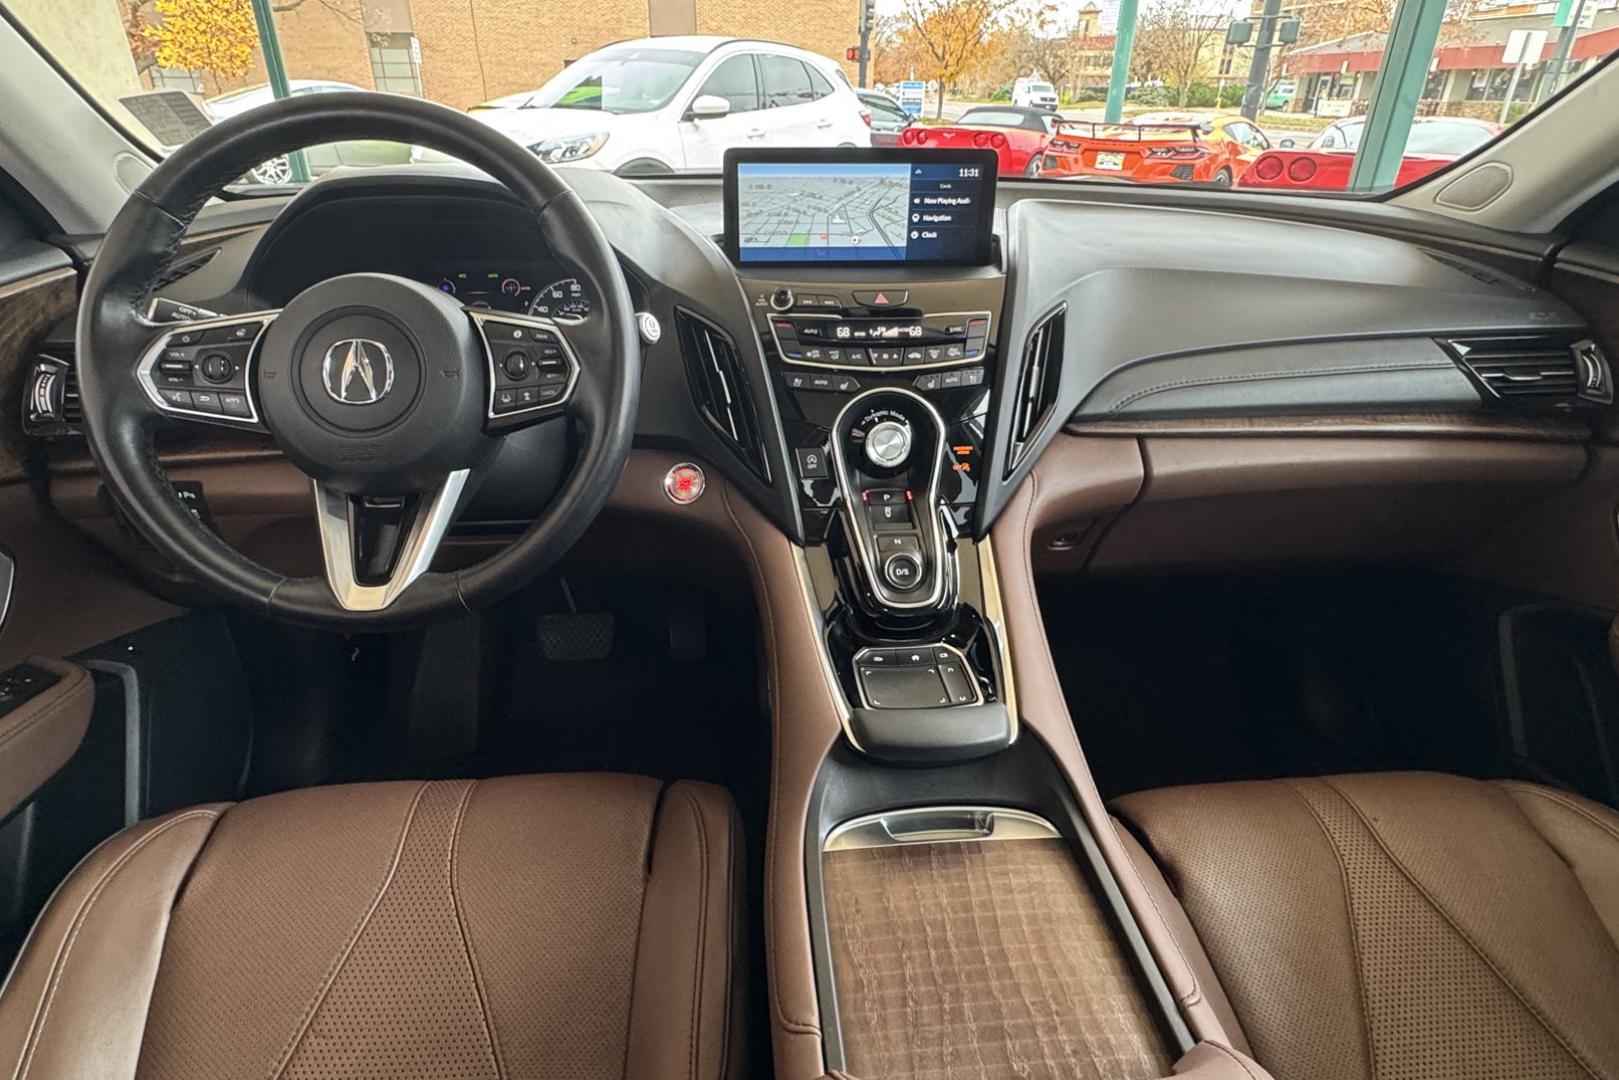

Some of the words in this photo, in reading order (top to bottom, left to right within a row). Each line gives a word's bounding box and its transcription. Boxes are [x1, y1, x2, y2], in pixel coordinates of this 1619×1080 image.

[959, 168, 979, 177] 11:31
[937, 197, 956, 206] Playing
[836, 327, 850, 337] 68
[909, 326, 922, 336] 68
[864, 410, 889, 422] Dynamic
[890, 410, 906, 421] Mode
